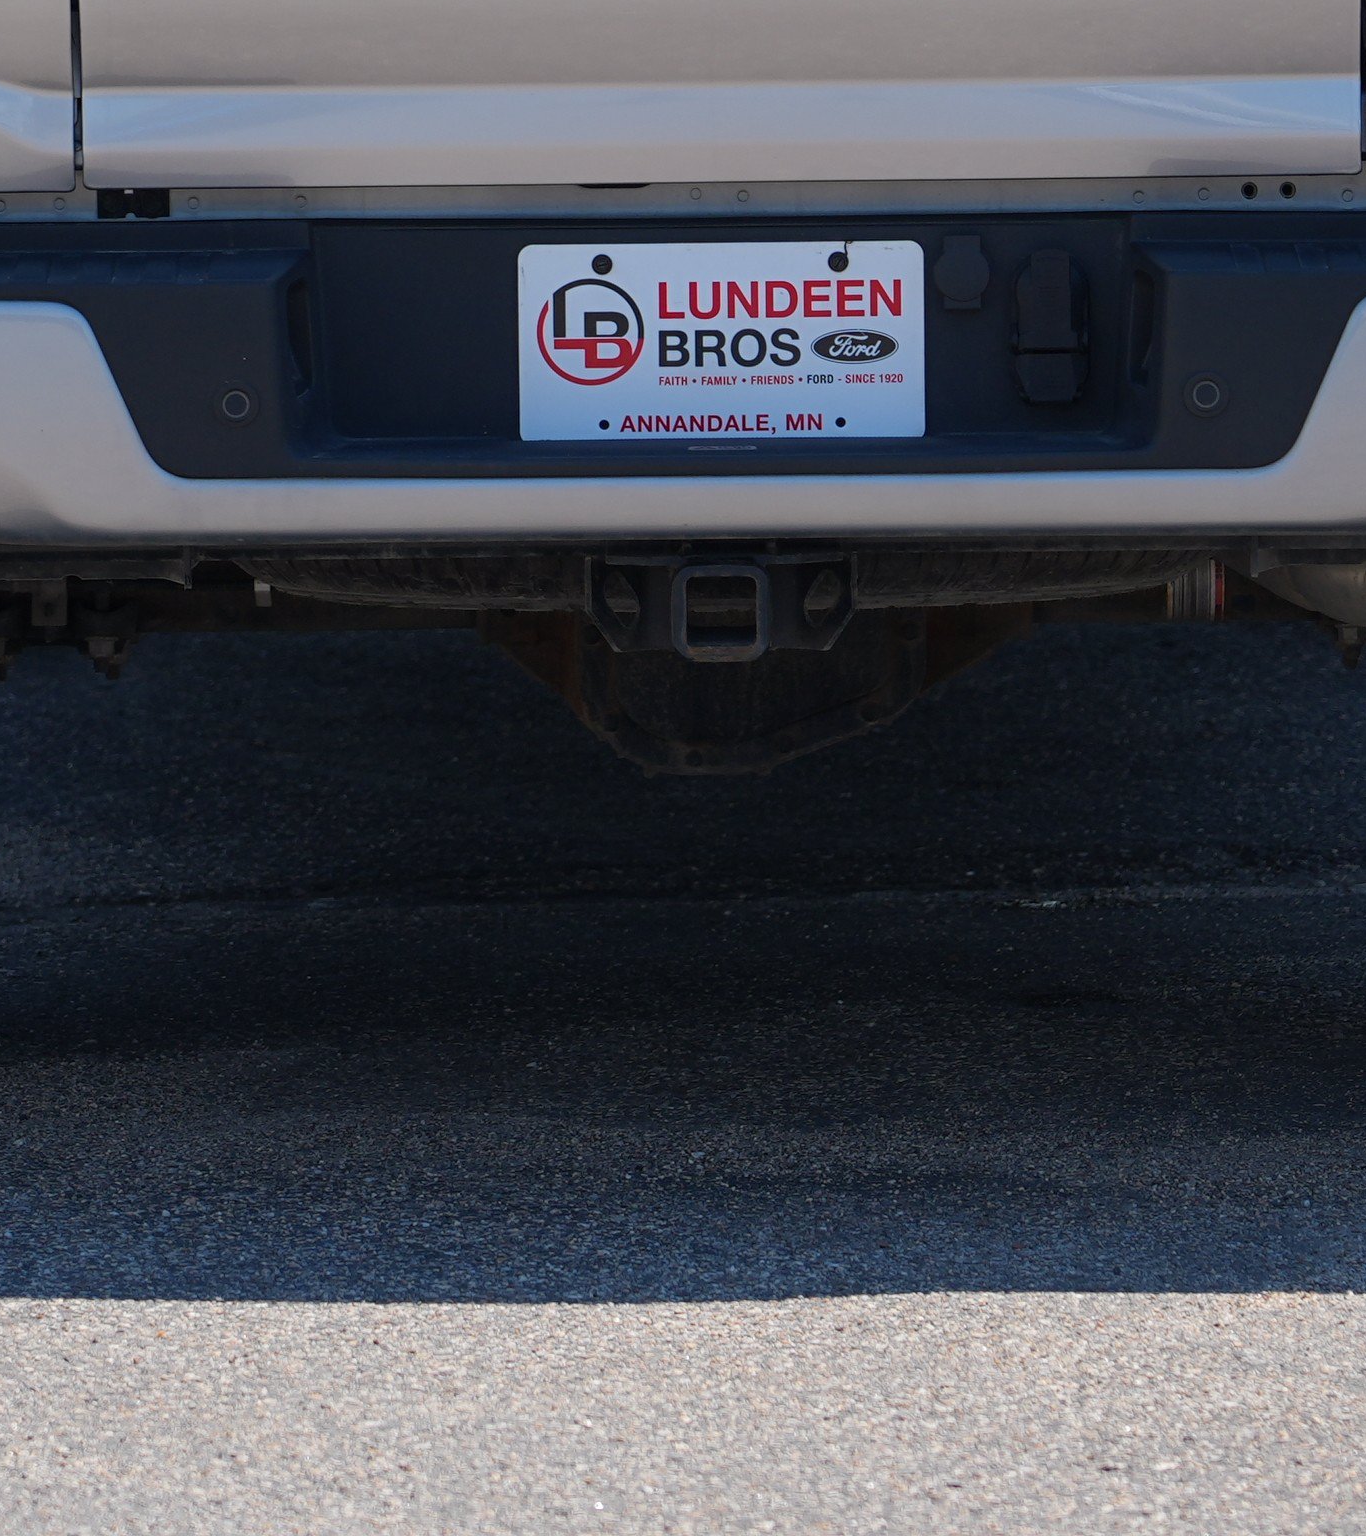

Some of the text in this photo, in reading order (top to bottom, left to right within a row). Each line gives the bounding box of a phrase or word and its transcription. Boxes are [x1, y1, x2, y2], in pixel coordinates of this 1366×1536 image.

[657, 279, 903, 319] LUNDEEN
[657, 328, 882, 368] BROS Ford
[659, 373, 904, 386] FAITH FAMILY FRIENDS FORD SINCE 1920
[619, 413, 823, 435] ANNANDALE, MN
